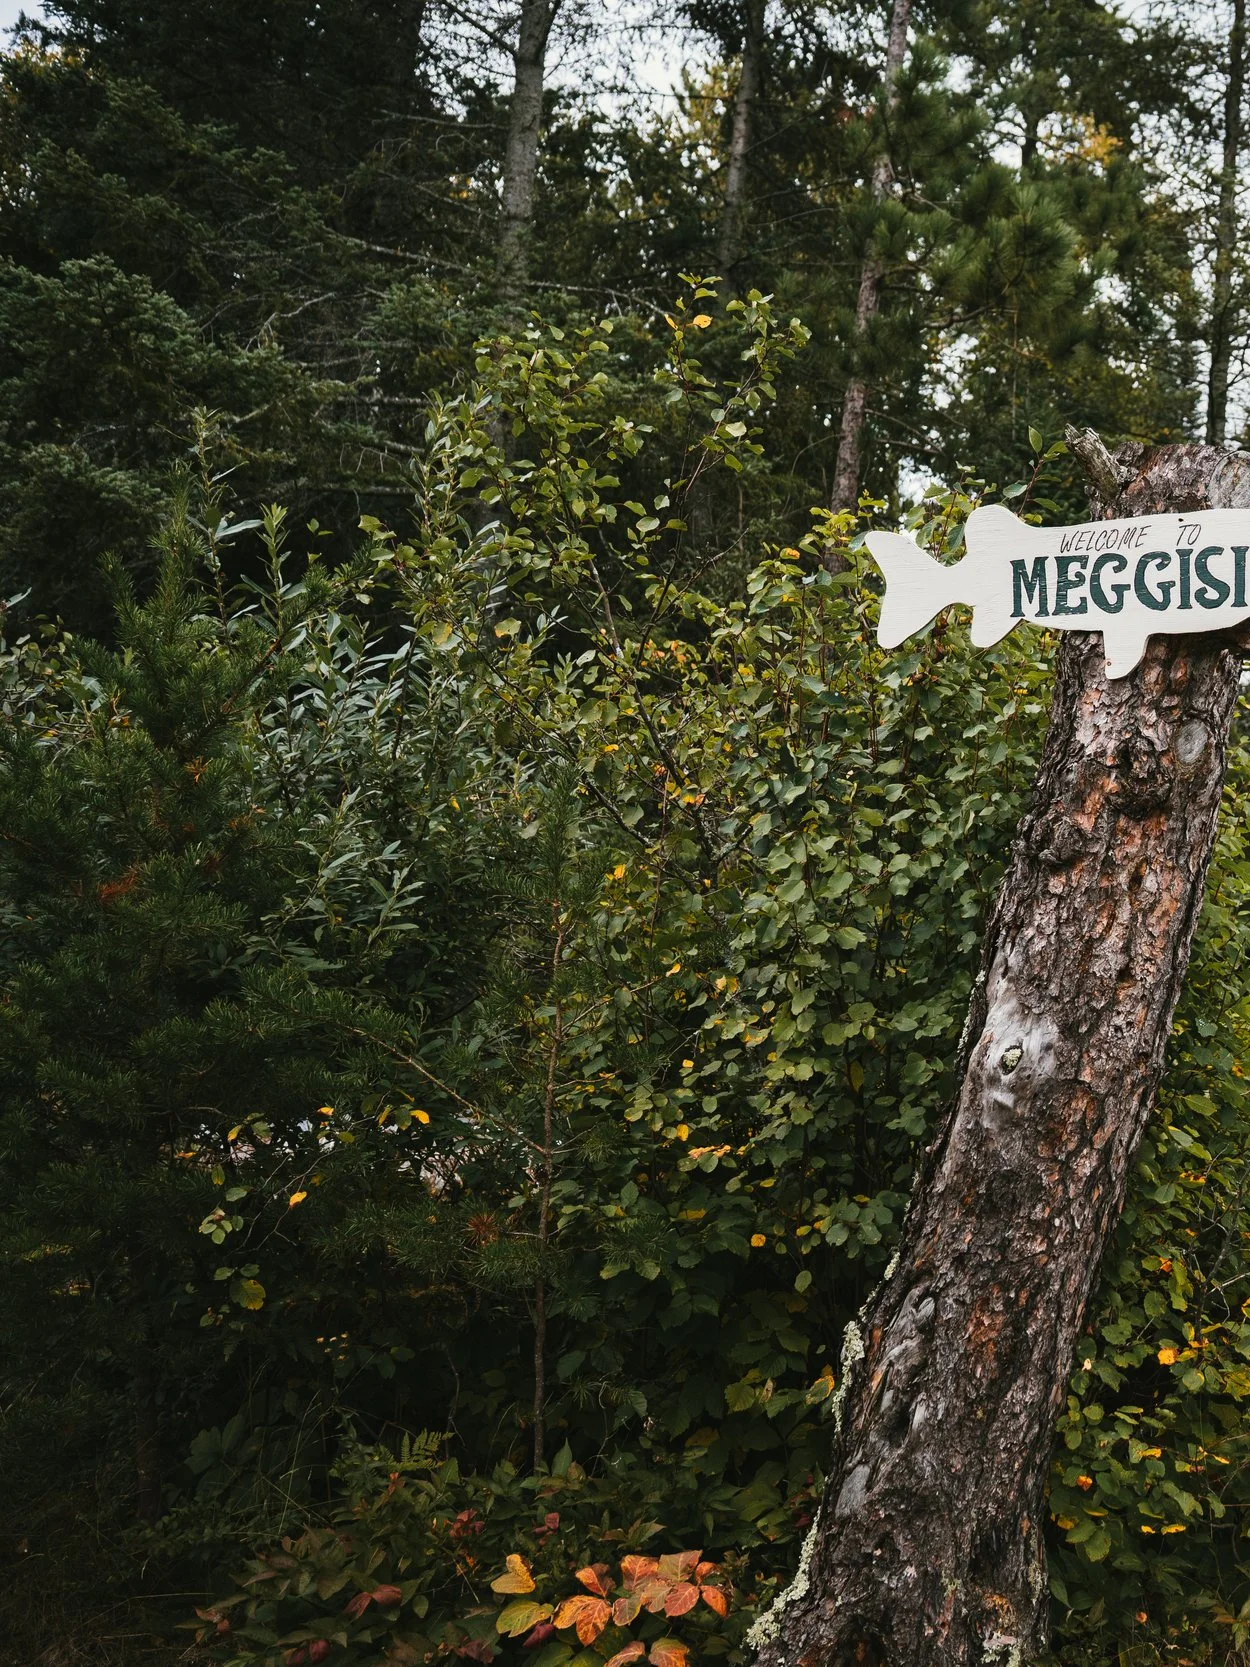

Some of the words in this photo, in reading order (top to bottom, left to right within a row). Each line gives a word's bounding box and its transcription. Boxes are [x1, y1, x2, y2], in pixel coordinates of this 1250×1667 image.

[1060, 525, 1152, 553] WELCOME
[1176, 523, 1202, 546] TO
[1009, 546, 1250, 618] MEGGISI
